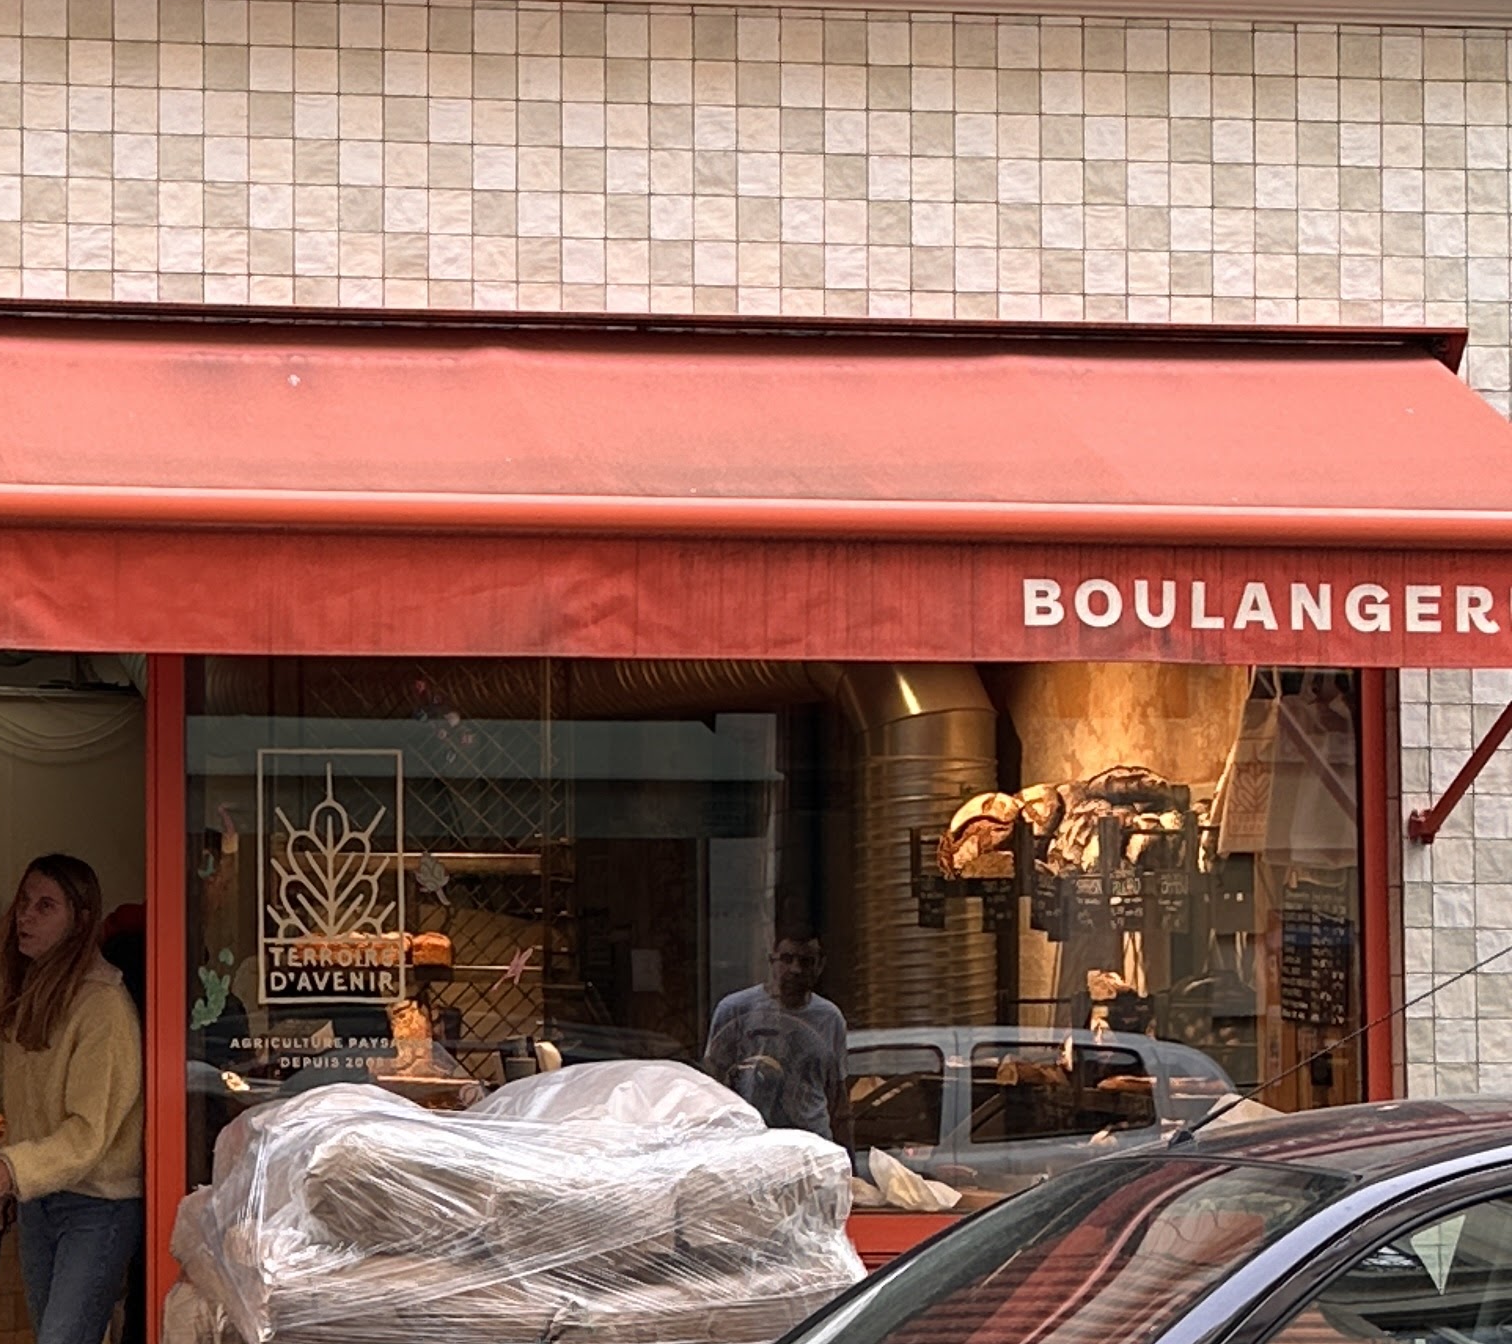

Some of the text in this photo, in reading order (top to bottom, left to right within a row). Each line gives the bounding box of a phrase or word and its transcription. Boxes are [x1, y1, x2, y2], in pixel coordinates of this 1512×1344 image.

[1022, 578, 1512, 634] BOULANGER
[269, 946, 394, 967] TERROIRS
[270, 970, 394, 992] D'AVENIR
[229, 1037, 344, 1049] AGRICULTURE
[279, 1056, 340, 1069] DEPUIS
